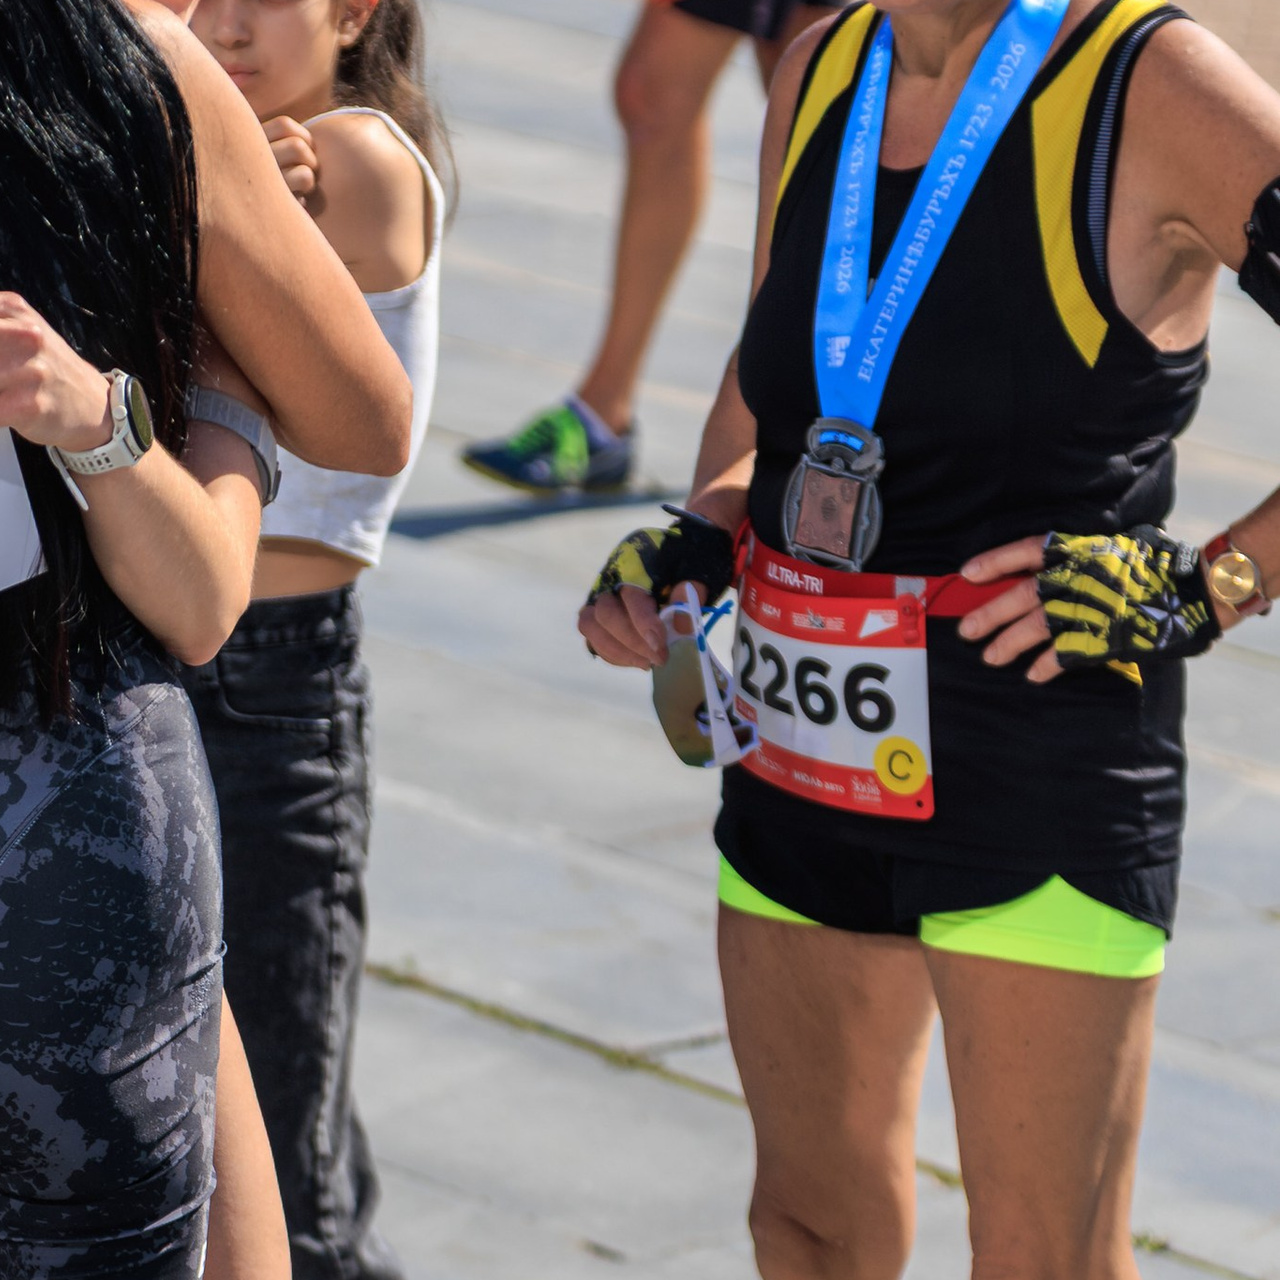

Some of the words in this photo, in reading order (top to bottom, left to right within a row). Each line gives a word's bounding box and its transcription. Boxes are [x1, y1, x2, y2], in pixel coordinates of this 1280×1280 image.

[959, 102, 994, 150] 1723
[991, 40, 1027, 91] 2026
[836, 244, 856, 294] 2026
[767, 560, 823, 595] ULTRA-TRI
[739, 626, 896, 734] 2266
